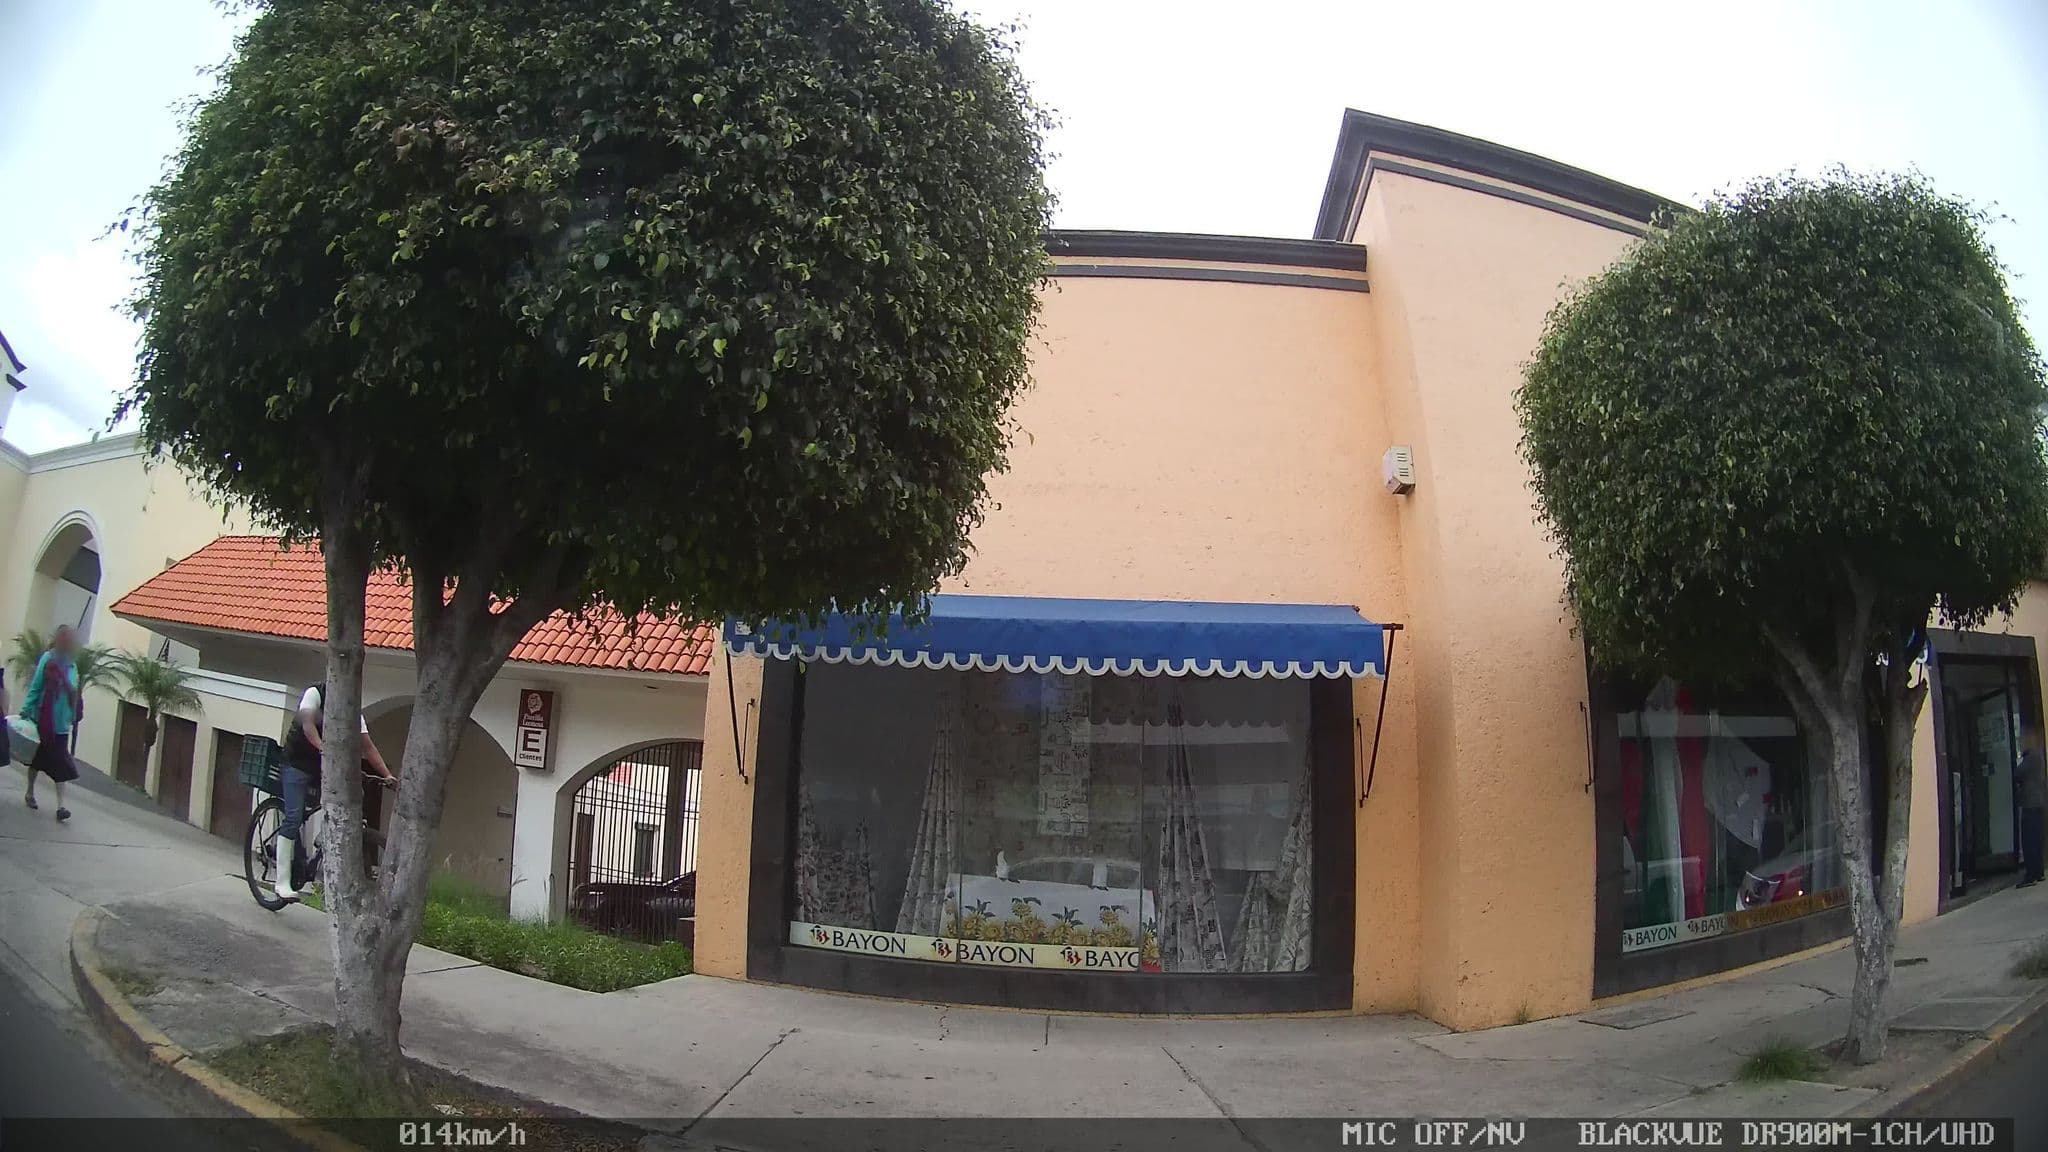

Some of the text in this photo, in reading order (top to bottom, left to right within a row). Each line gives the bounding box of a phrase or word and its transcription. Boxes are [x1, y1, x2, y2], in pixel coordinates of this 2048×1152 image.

[523, 729, 541, 752] E
[832, 930, 906, 954] BAYON
[957, 942, 1035, 964] BAYON
[1635, 926, 1677, 945] BAYON
